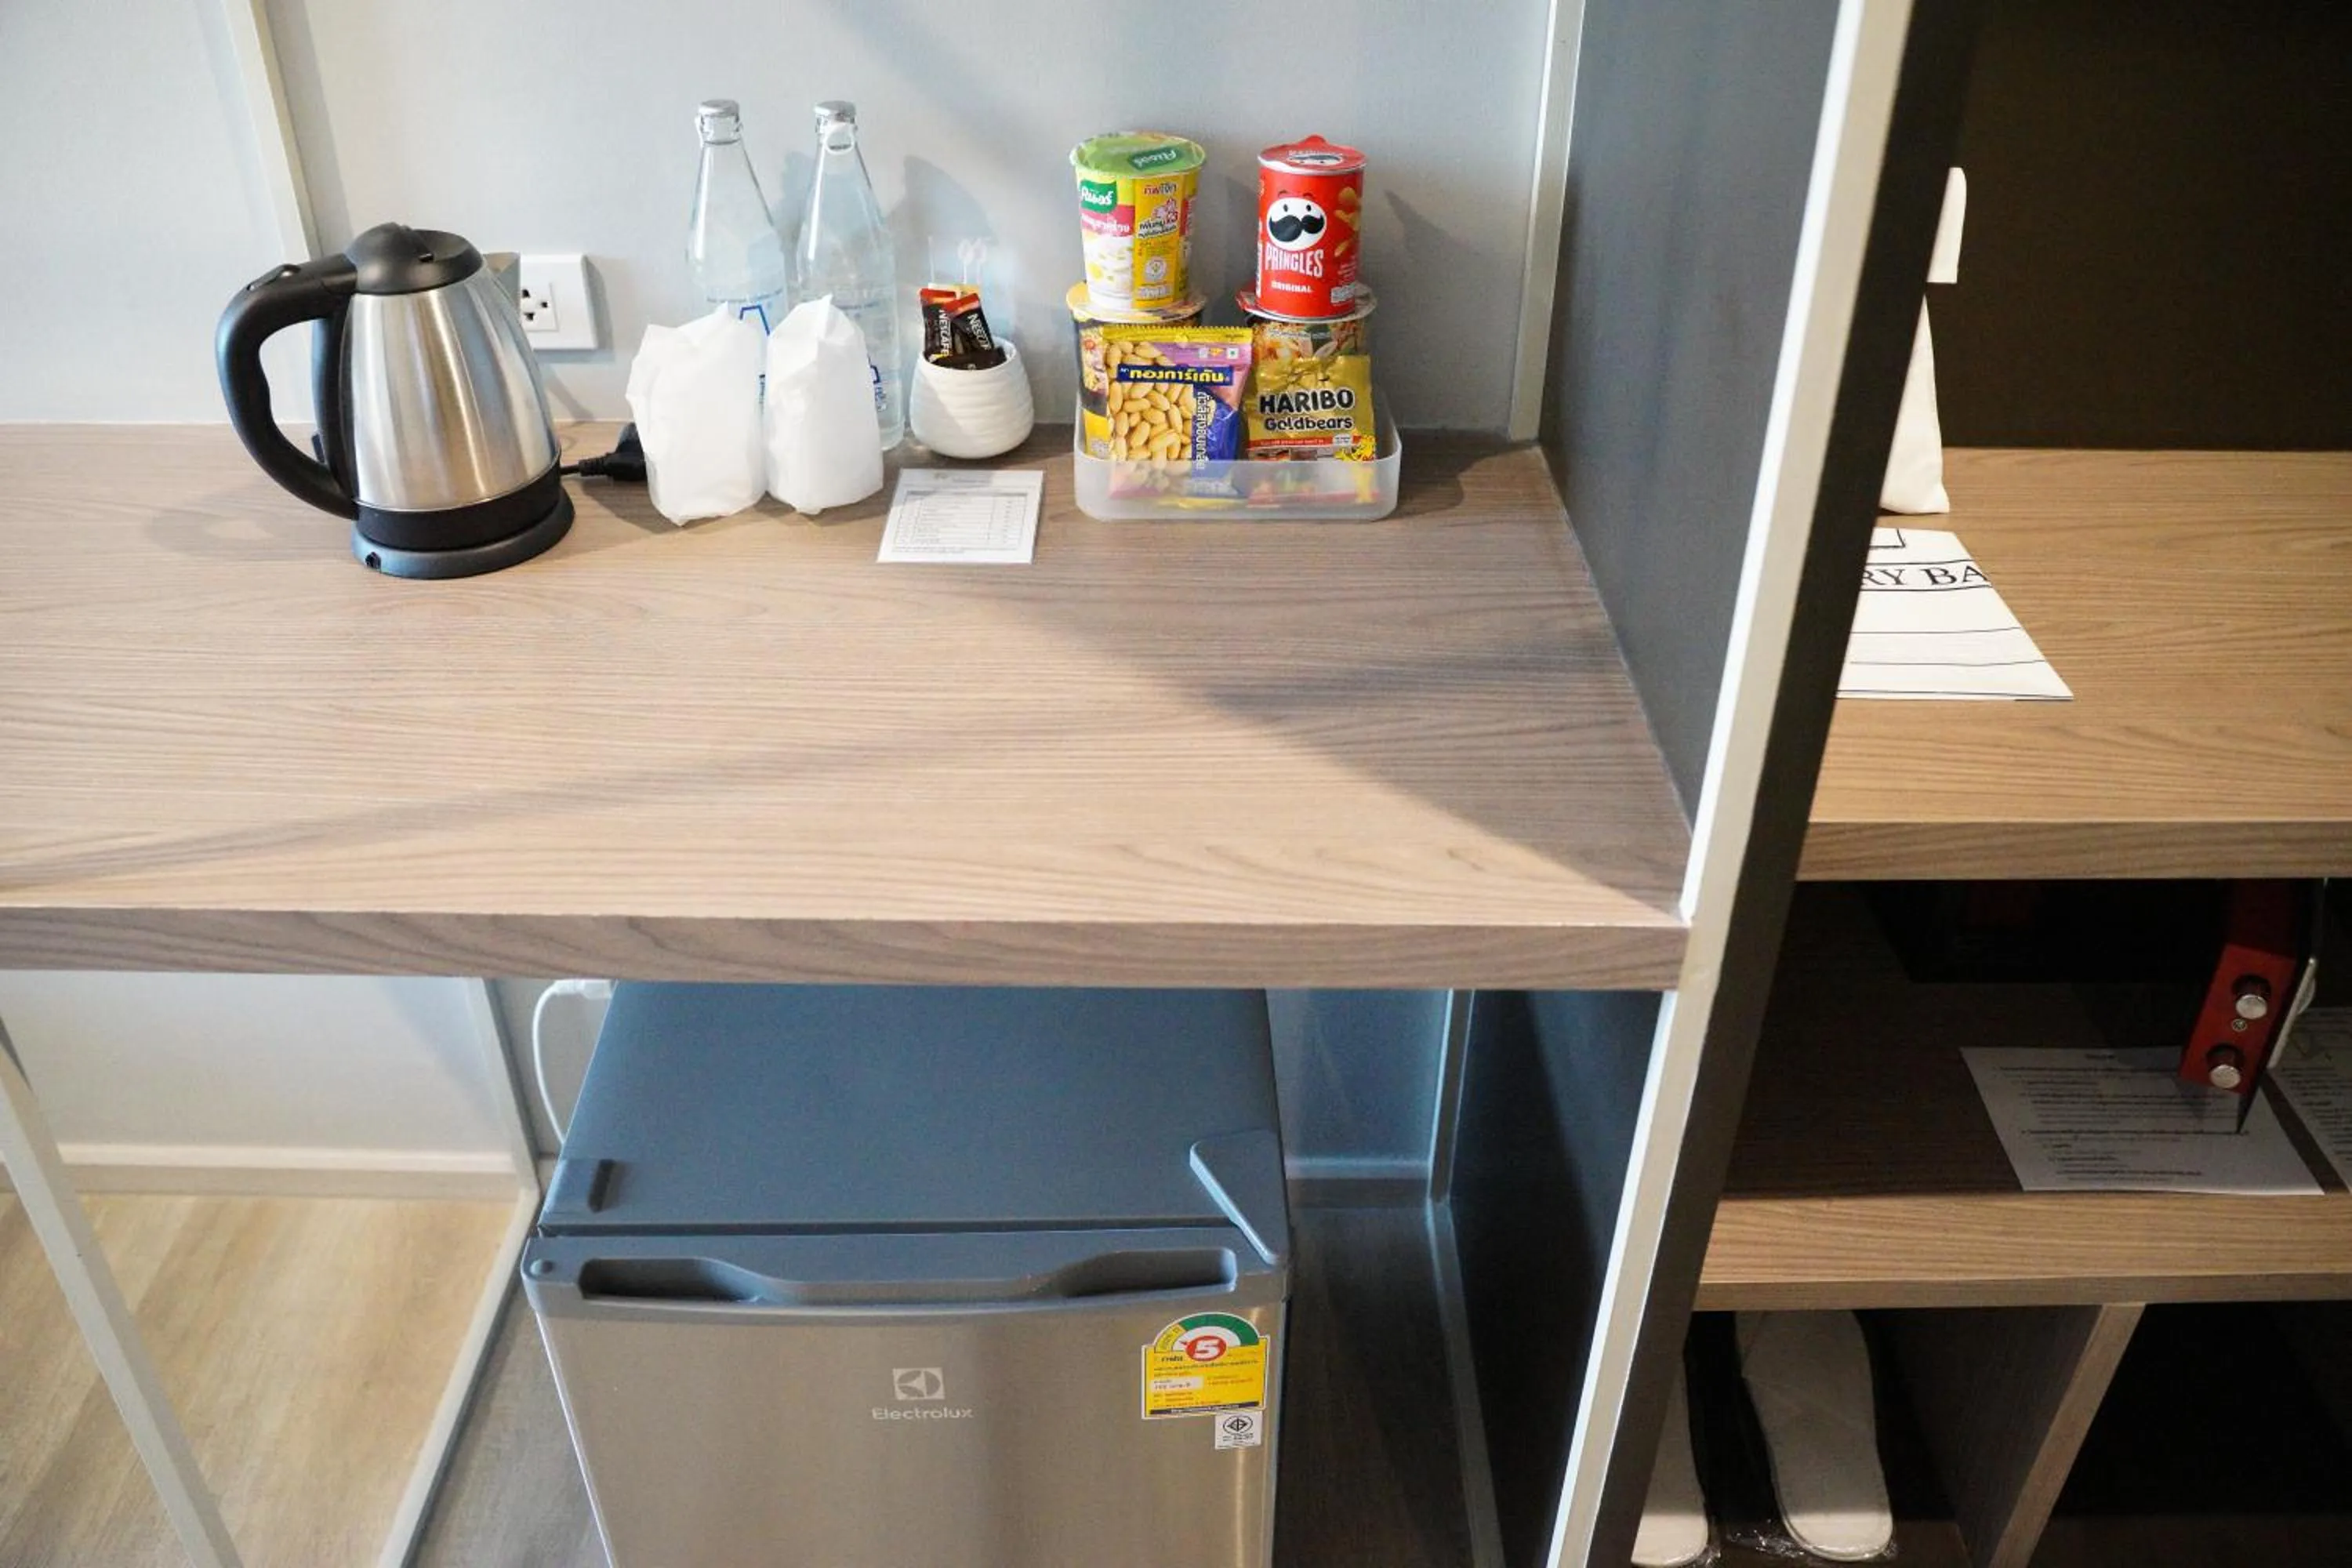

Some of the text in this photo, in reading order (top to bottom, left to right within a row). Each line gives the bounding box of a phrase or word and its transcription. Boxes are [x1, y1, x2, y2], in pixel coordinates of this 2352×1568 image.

[1265, 242, 1325, 278] PRINGLES
[1271, 280, 1312, 293] ORIGINAL
[1259, 389, 1355, 414] HARIBO
[1264, 417, 1353, 431] Goldbears
[1192, 1339, 1222, 1359] 5
[872, 1406, 974, 1421] Electrolux
